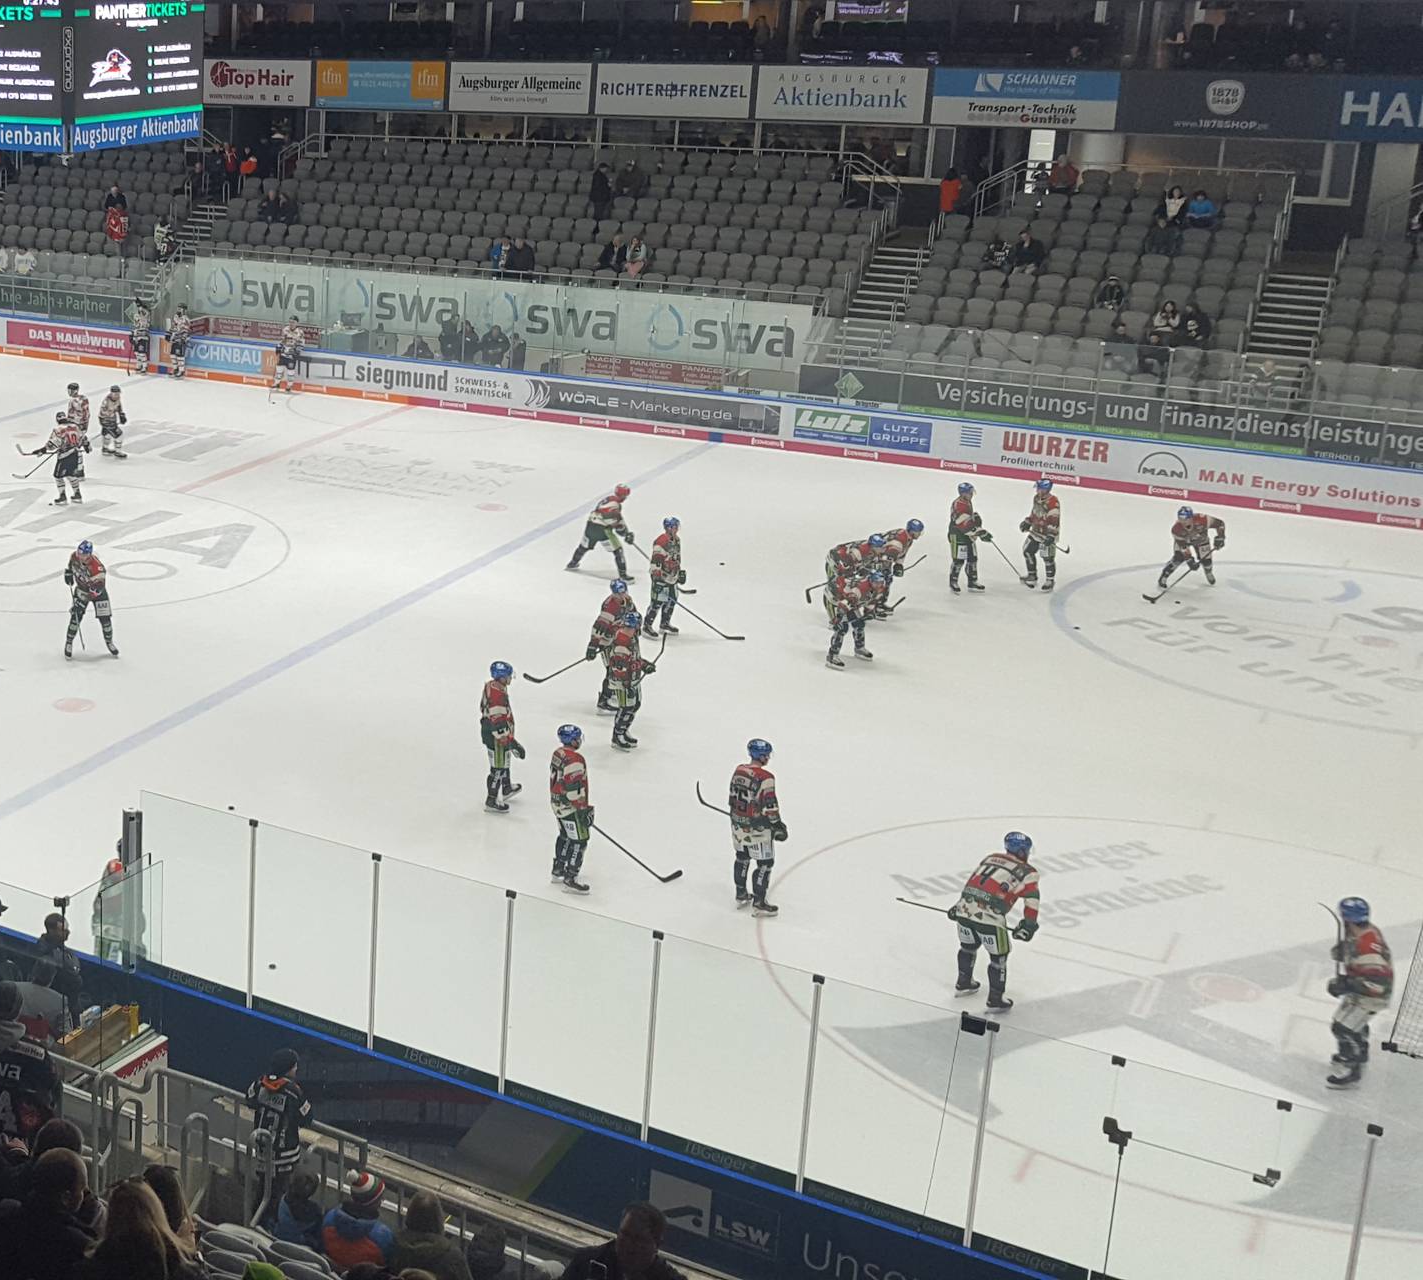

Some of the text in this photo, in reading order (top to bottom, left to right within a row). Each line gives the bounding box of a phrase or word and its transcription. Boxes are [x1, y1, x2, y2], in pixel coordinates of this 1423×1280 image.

[95, 2, 187, 20] PANTHERTICKETS
[227, 68, 294, 88] Top Hair
[321, 67, 342, 84] tfm
[416, 69, 438, 87] tfm
[458, 74, 582, 91] Augsburger Allgemeine
[779, 73, 907, 84] AUGSBURGER
[1006, 73, 1076, 87] SCHANNER
[600, 82, 748, 98] RICHTER FRENZEL
[774, 87, 907, 109] Aktienbank
[1211, 87, 1239, 98] 1878
[1340, 90, 1423, 128] HA
[1020, 113, 1077, 125] Günther
[74, 112, 199, 149] Augsburger Aktienbank
[241, 279, 315, 313] swa
[375, 290, 459, 325] swa
[526, 303, 618, 342] swa
[28, 328, 53, 342] DAS
[56, 329, 125, 350] HANDWERK
[692, 317, 795, 359] swa
[355, 360, 449, 392] siegmund
[454, 376, 509, 390] SCHWEISS- &
[454, 385, 513, 400] SPANNTISCHE
[935, 381, 1096, 419] Versicherungs-
[1105, 402, 1150, 422] und
[796, 410, 868, 433] Lutz
[882, 423, 919, 434] LUTZ
[872, 432, 928, 446] GRUPPE
[1002, 430, 1110, 463] WURZER
[1000, 455, 1076, 472] Profiliertechnik
[1141, 466, 1186, 479] MAN
[1198, 468, 1422, 508] MAN Energy Solutions
[714, 1214, 771, 1248] LSW
